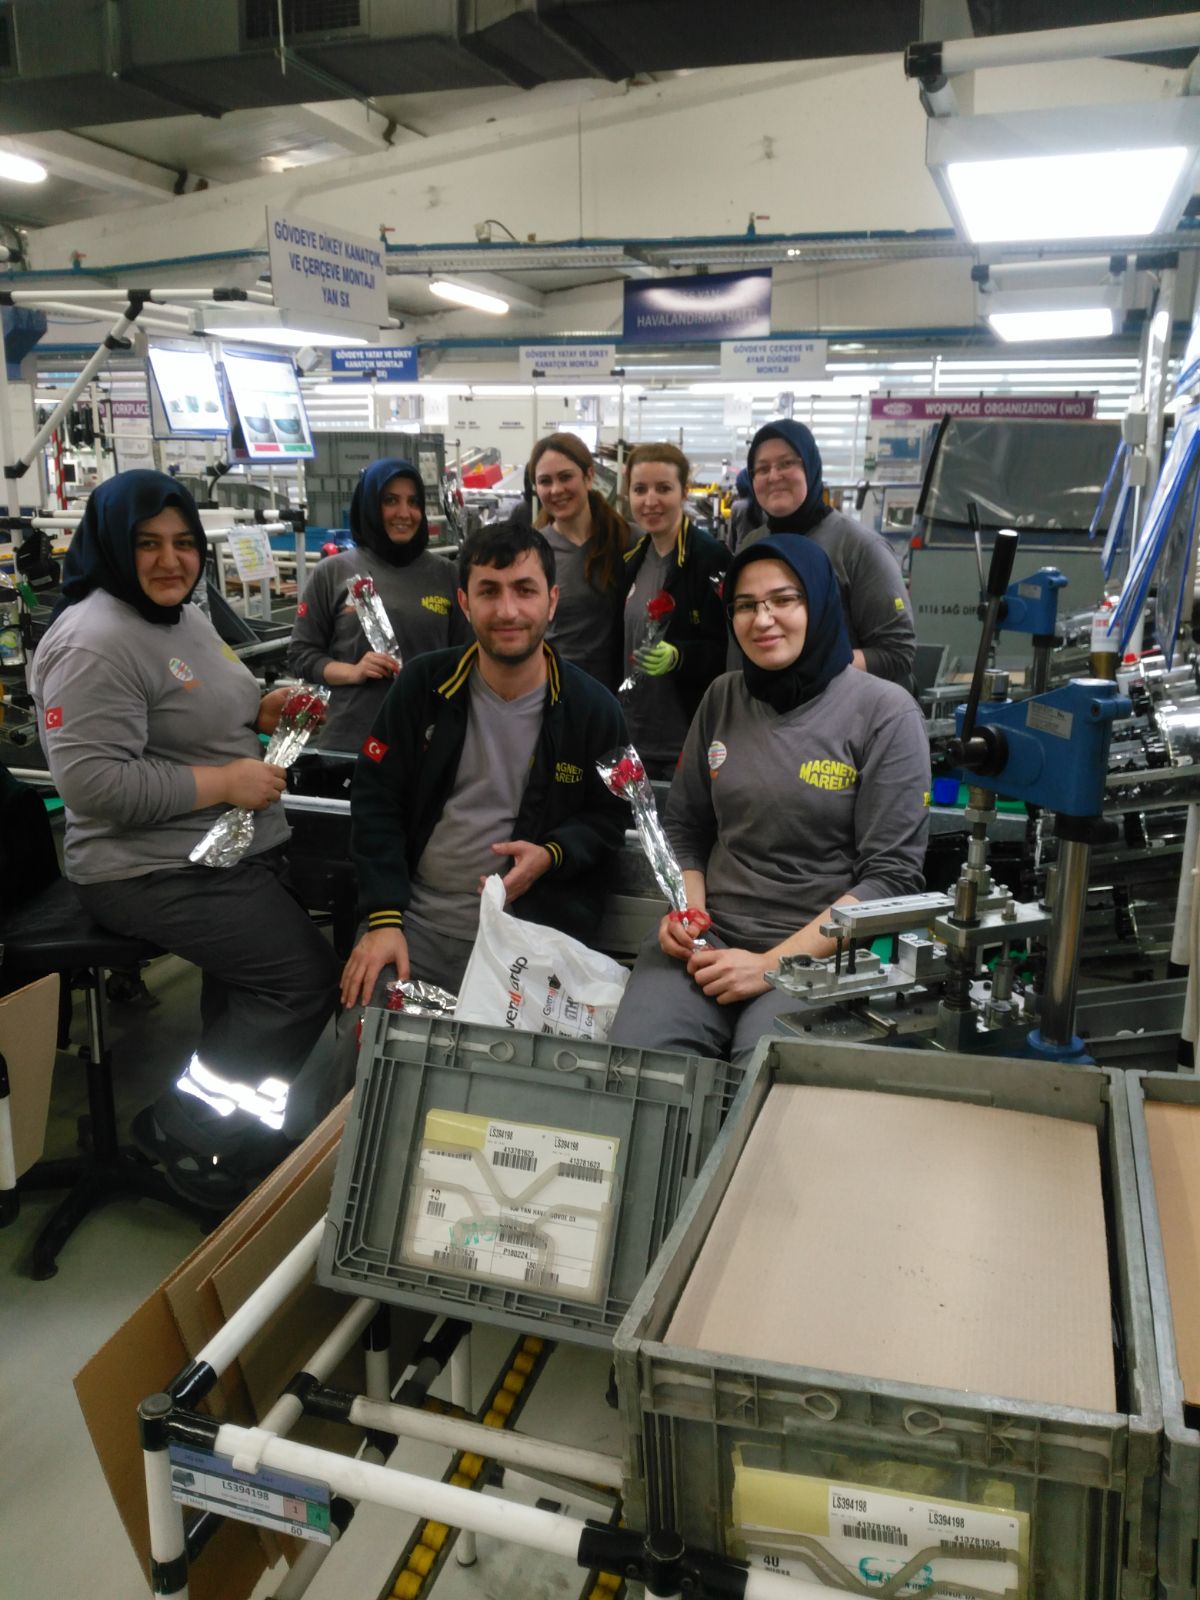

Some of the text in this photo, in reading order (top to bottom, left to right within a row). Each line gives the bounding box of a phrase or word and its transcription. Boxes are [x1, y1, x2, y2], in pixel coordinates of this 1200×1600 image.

[274, 219, 317, 250] GÖVDEYE
[318, 231, 342, 256] DİKEY
[289, 252, 375, 290] VE ÇERÇEVE MONTAJI
[321, 287, 339, 306] YAN
[636, 309, 724, 328] HAVALANDIRMA
[805, 343, 814, 352] VE
[756, 365, 789, 373] MONTAJI
[925, 402, 979, 415] WORKPLACE
[984, 401, 1057, 415] ORGANIZATION
[1060, 402, 1086, 416] (WO)
[221, 1480, 270, 1501] LS394198
[832, 1495, 867, 1513] LS394198
[928, 1512, 965, 1529] LS394198
